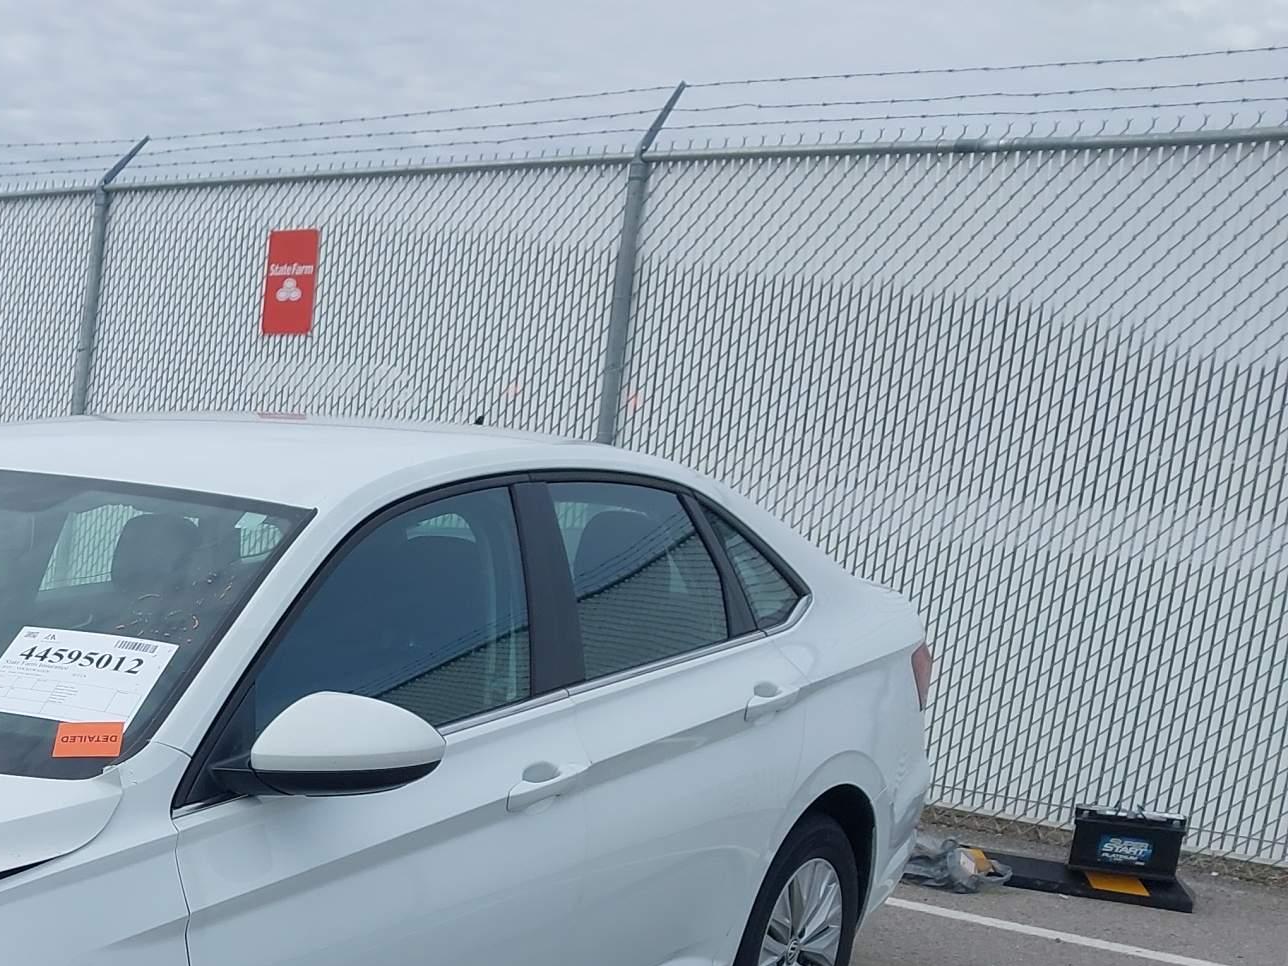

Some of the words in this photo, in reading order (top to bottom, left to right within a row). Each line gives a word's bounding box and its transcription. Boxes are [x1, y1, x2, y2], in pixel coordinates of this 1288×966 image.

[19, 645, 144, 675] 44595012
[60, 734, 119, 745] DETAILED
[1101, 842, 1148, 857] START
